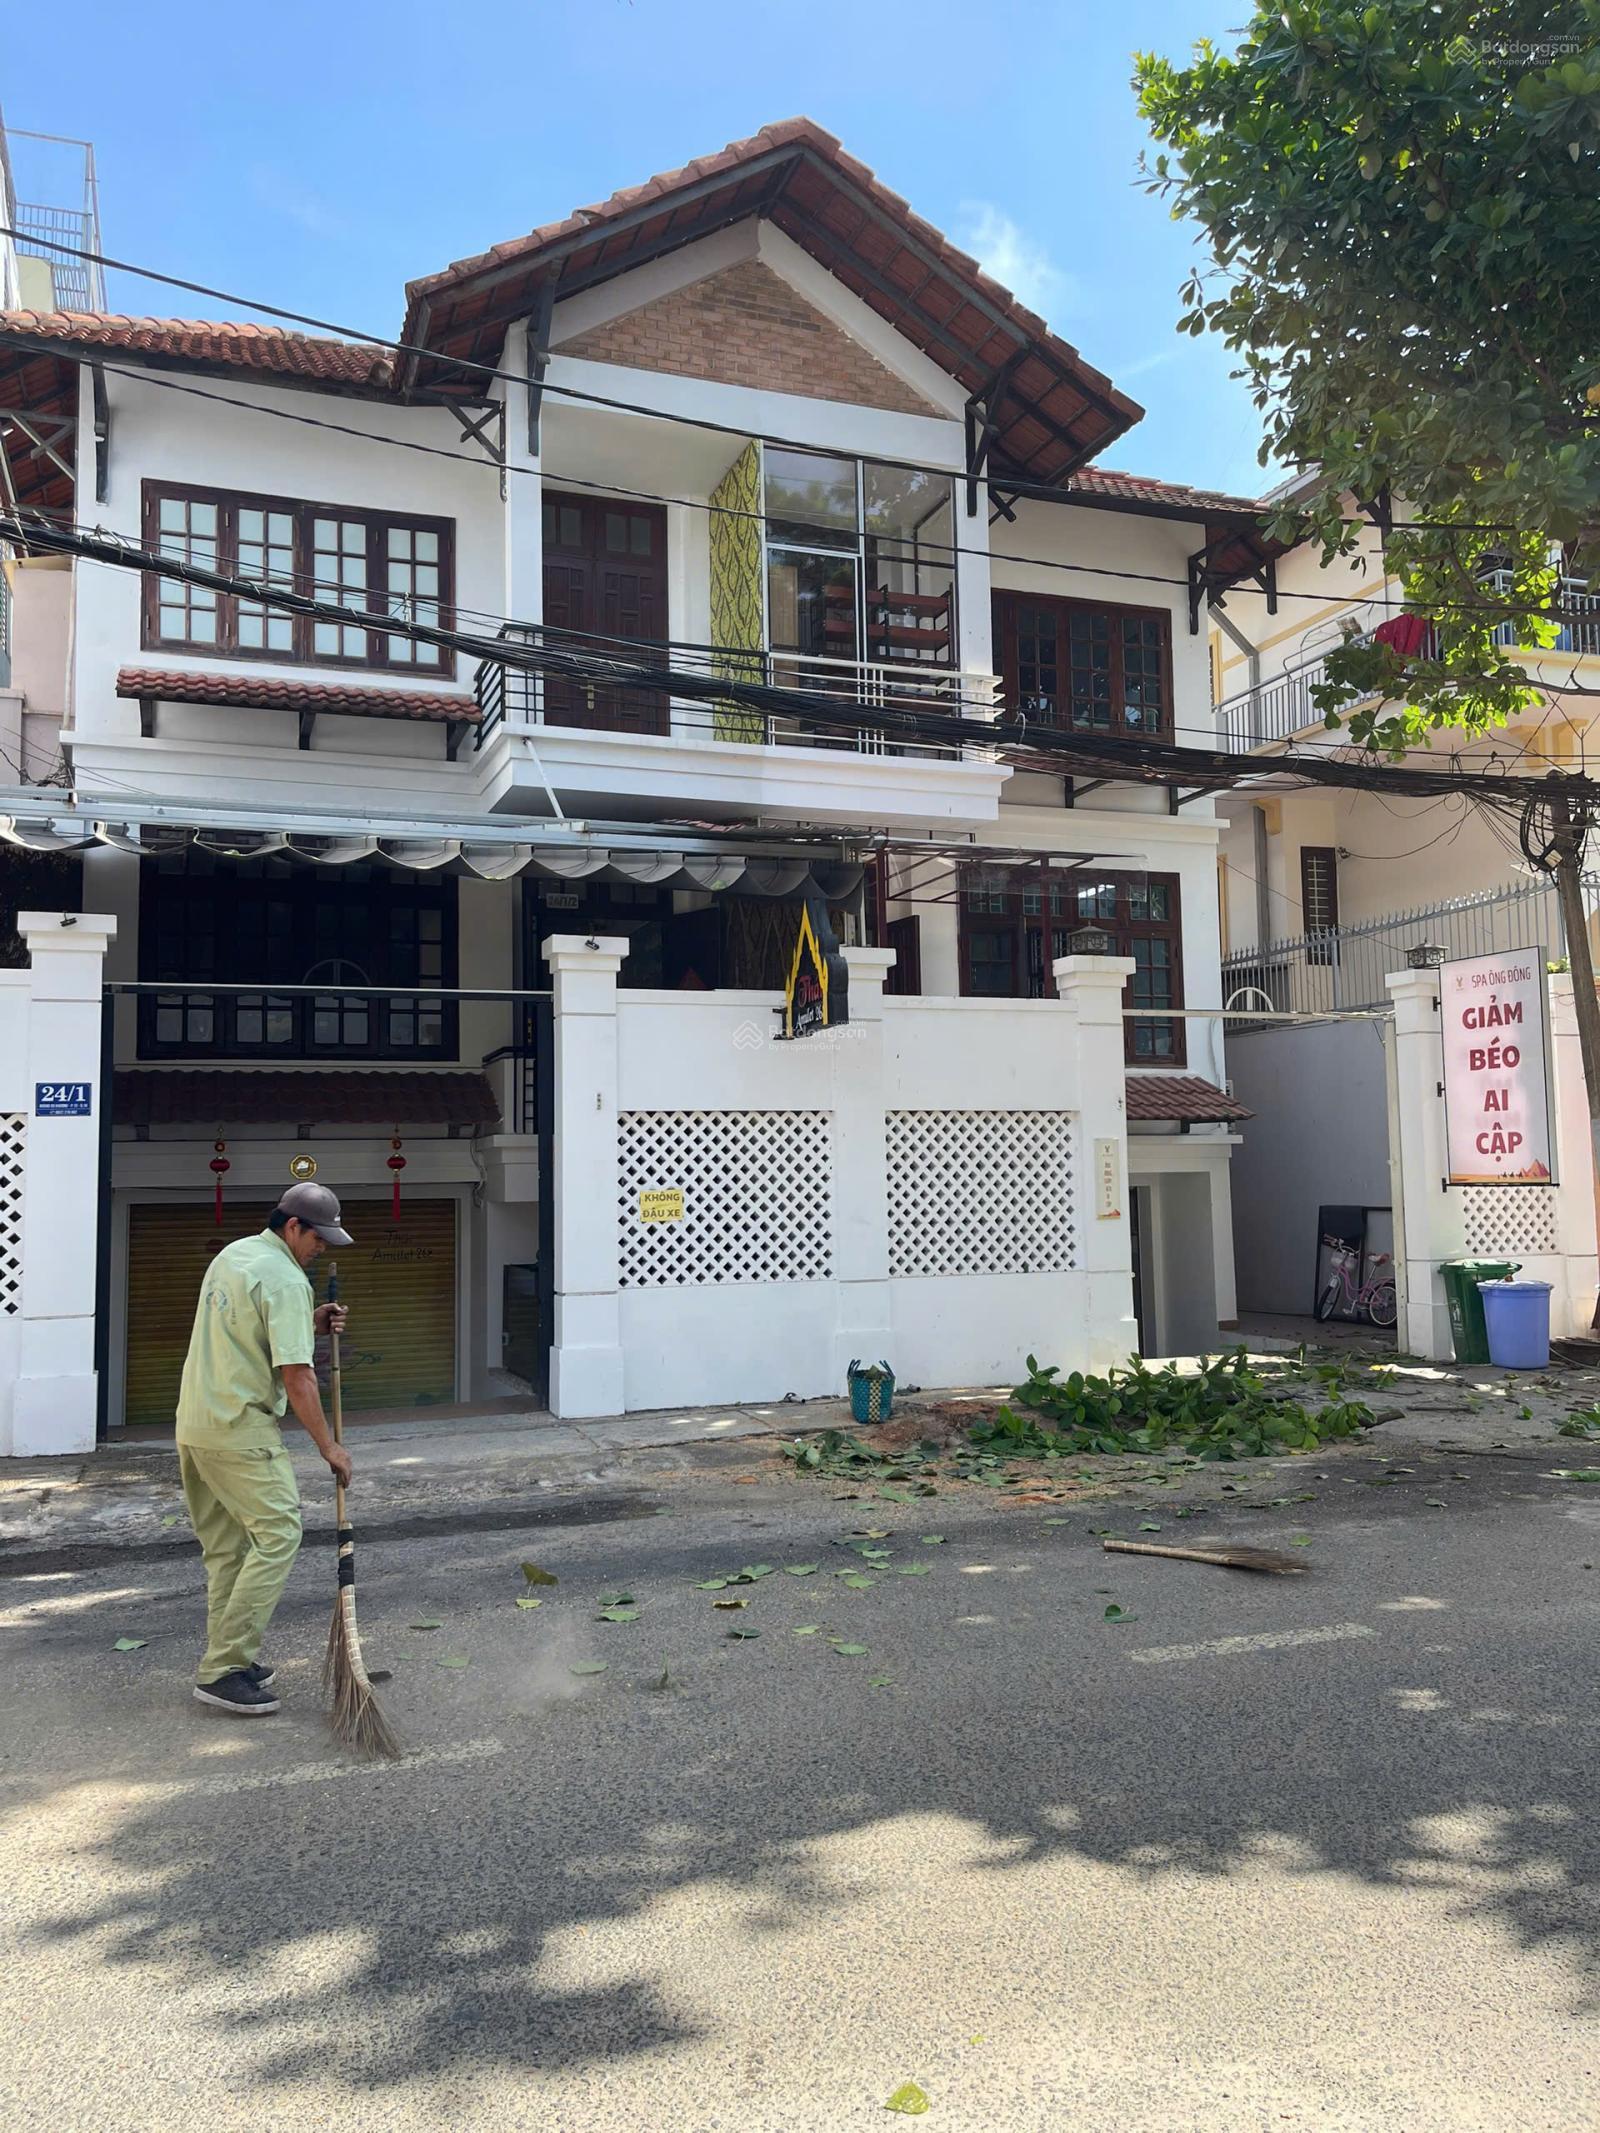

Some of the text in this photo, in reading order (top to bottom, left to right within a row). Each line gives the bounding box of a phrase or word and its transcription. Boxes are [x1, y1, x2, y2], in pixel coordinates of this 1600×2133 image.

[1471, 974, 1488, 989] SPA
[1462, 994, 1523, 1030] GIẢM
[1469, 1036, 1521, 1072] BÉO
[41, 1085, 86, 1102] 24/1
[1483, 1089, 1509, 1112] AI
[1476, 1121, 1523, 1162] CẬP
[644, 1191, 680, 1202] KHÔNG
[667, 1209, 681, 1217] XE
